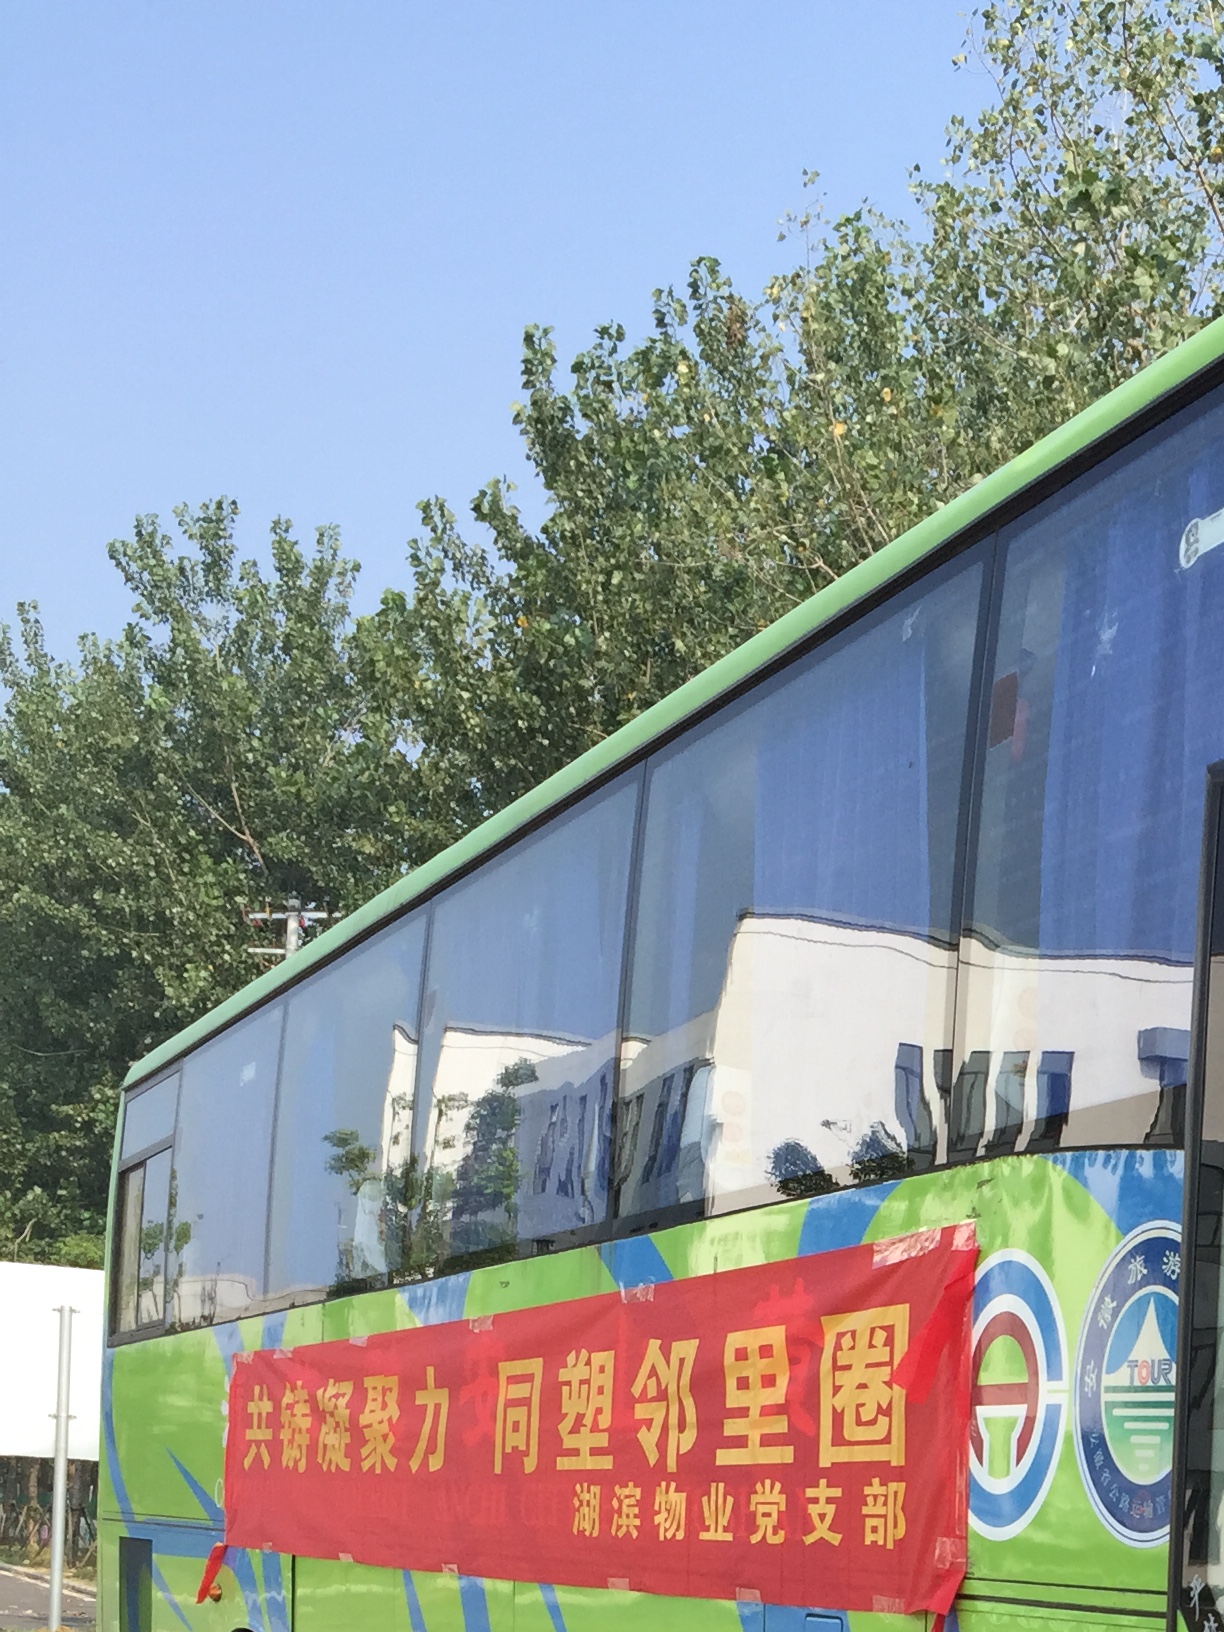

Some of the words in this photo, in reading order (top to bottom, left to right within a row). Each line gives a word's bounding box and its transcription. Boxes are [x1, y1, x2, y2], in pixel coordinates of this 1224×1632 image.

[243, 1366, 450, 1475] 共铸凝聚力
[494, 1303, 910, 1475] 同塑邻里圈
[1126, 1359, 1172, 1385] TOUR
[572, 1477, 907, 1549] 湖滨物业党支部
